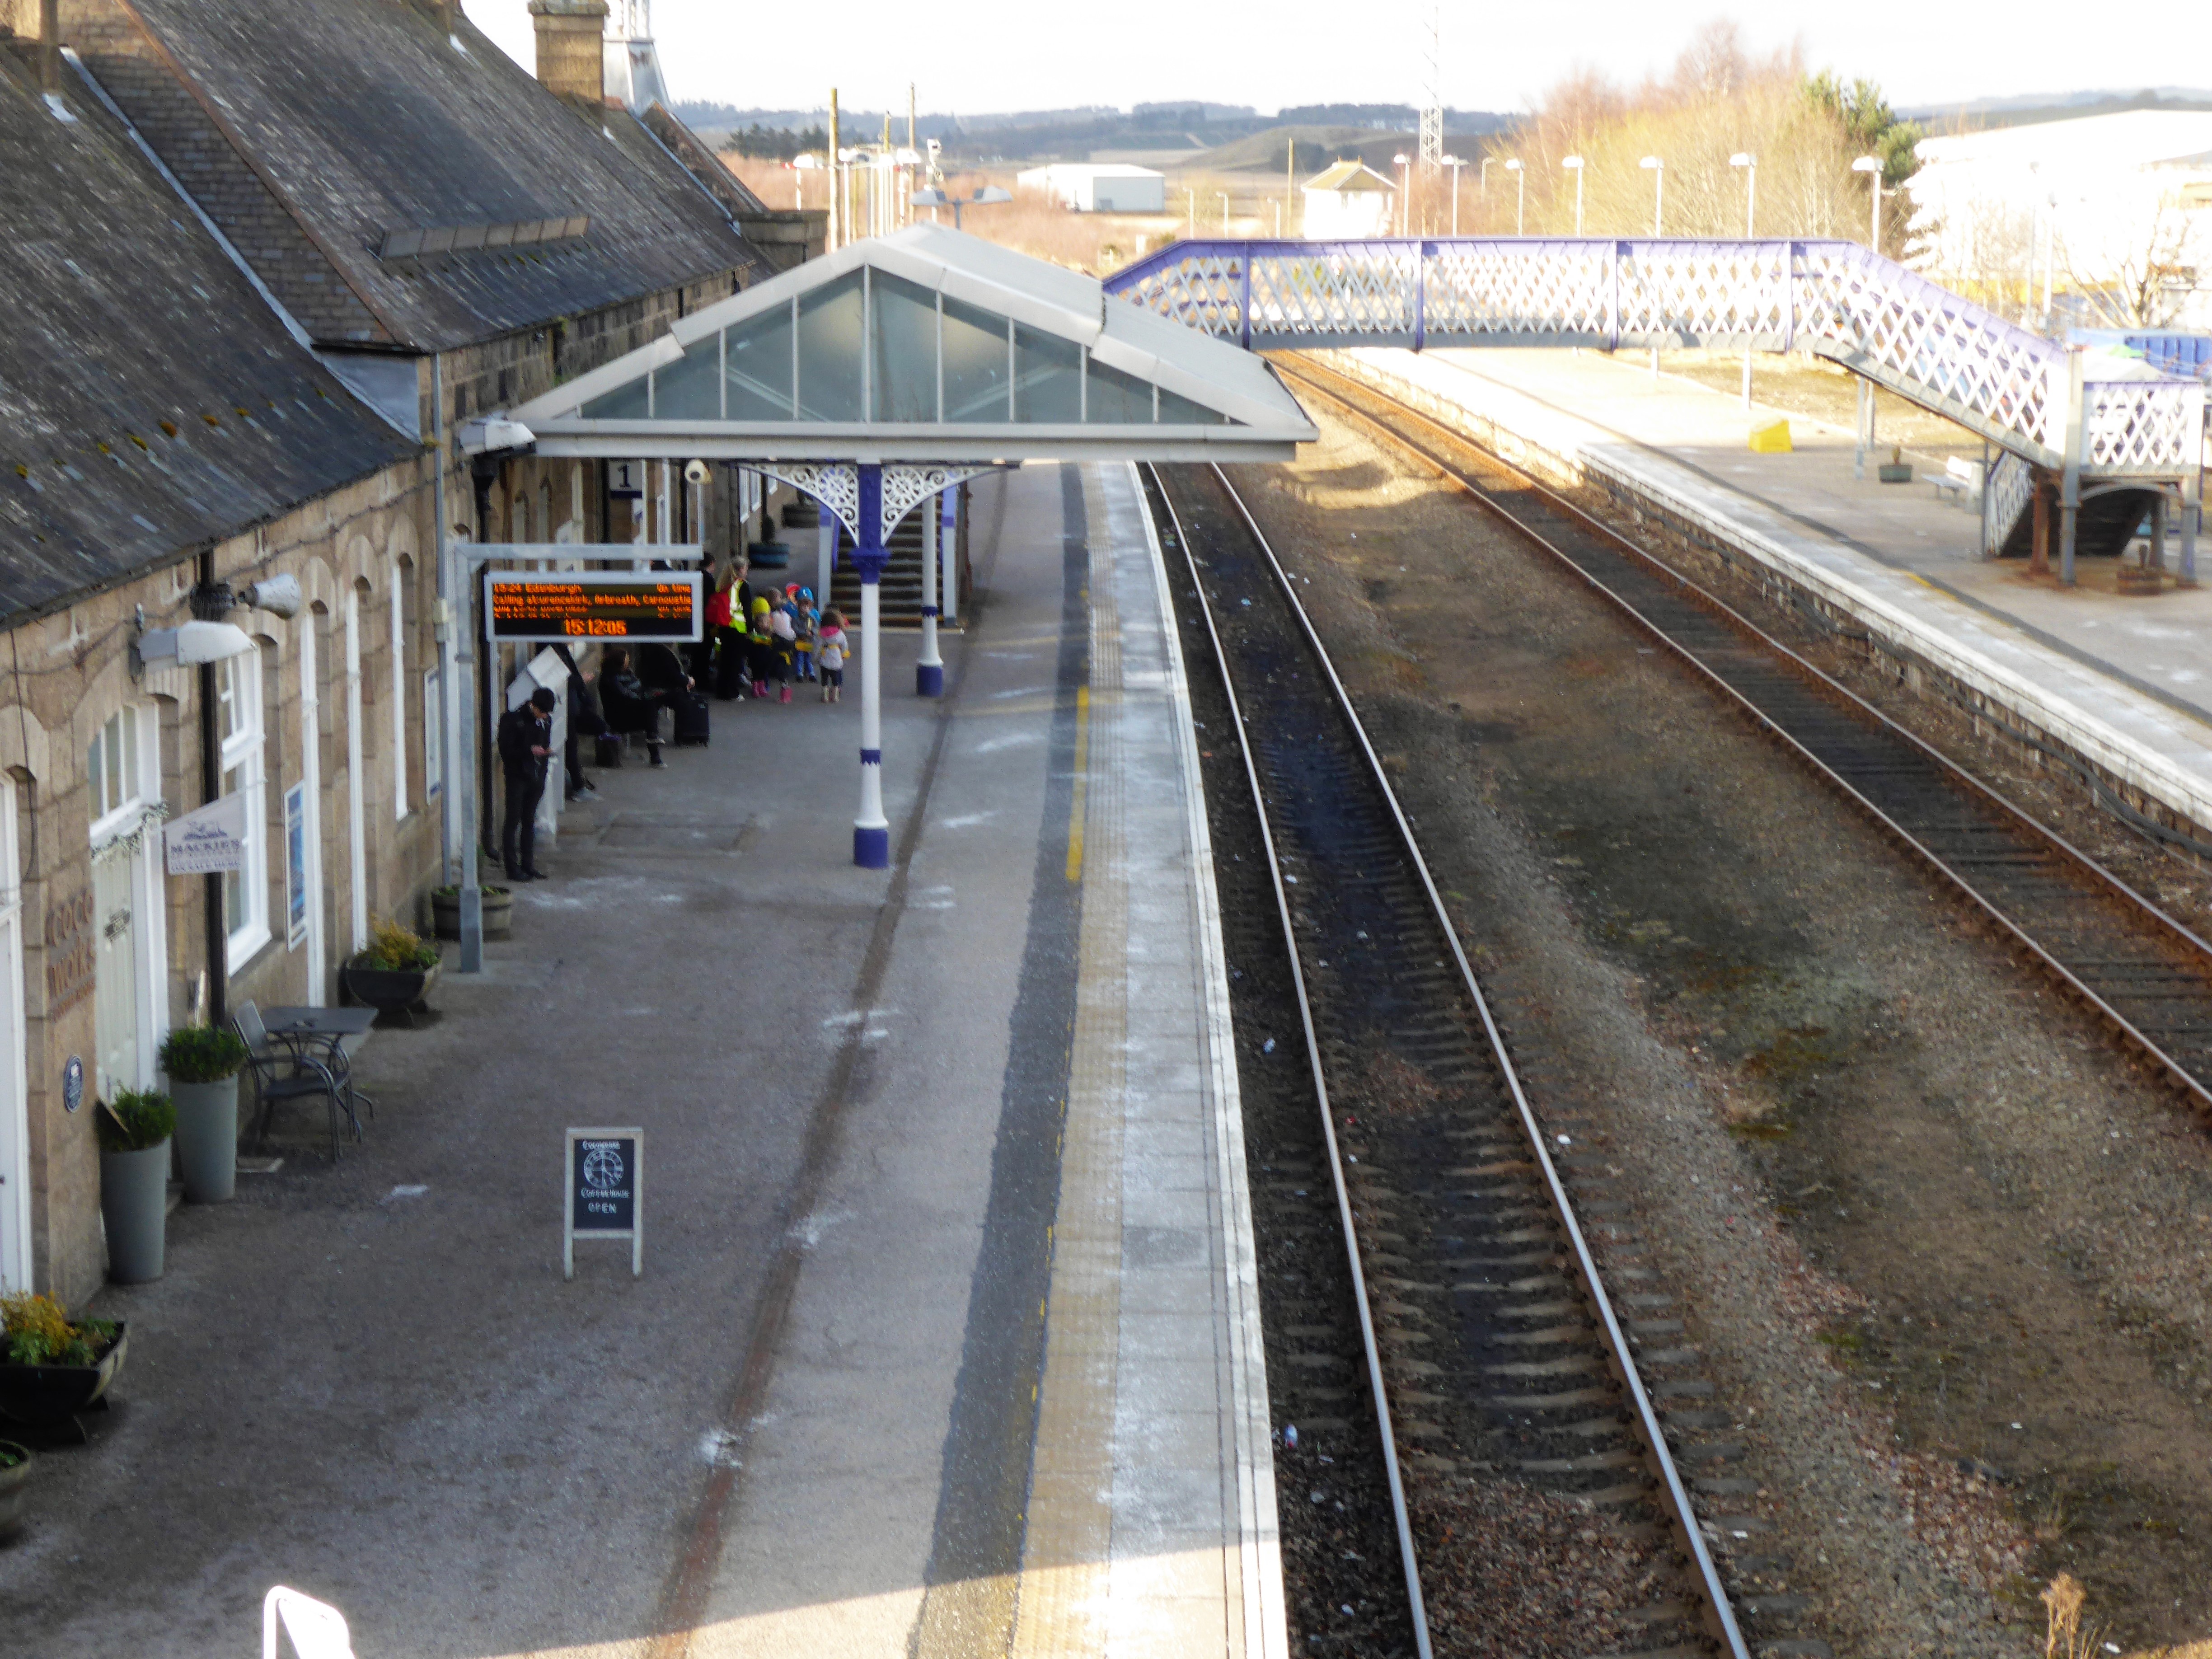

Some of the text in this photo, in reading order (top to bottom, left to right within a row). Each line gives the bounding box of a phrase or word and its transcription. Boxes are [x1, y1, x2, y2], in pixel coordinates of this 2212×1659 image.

[618, 464, 631, 487] 1
[525, 583, 582, 595] Edinburgh
[657, 583, 669, 593] On
[672, 583, 691, 593] time
[493, 594, 524, 606] Calling
[566, 618, 627, 635] 15:12:05
[588, 1202, 617, 1214] OPEN
